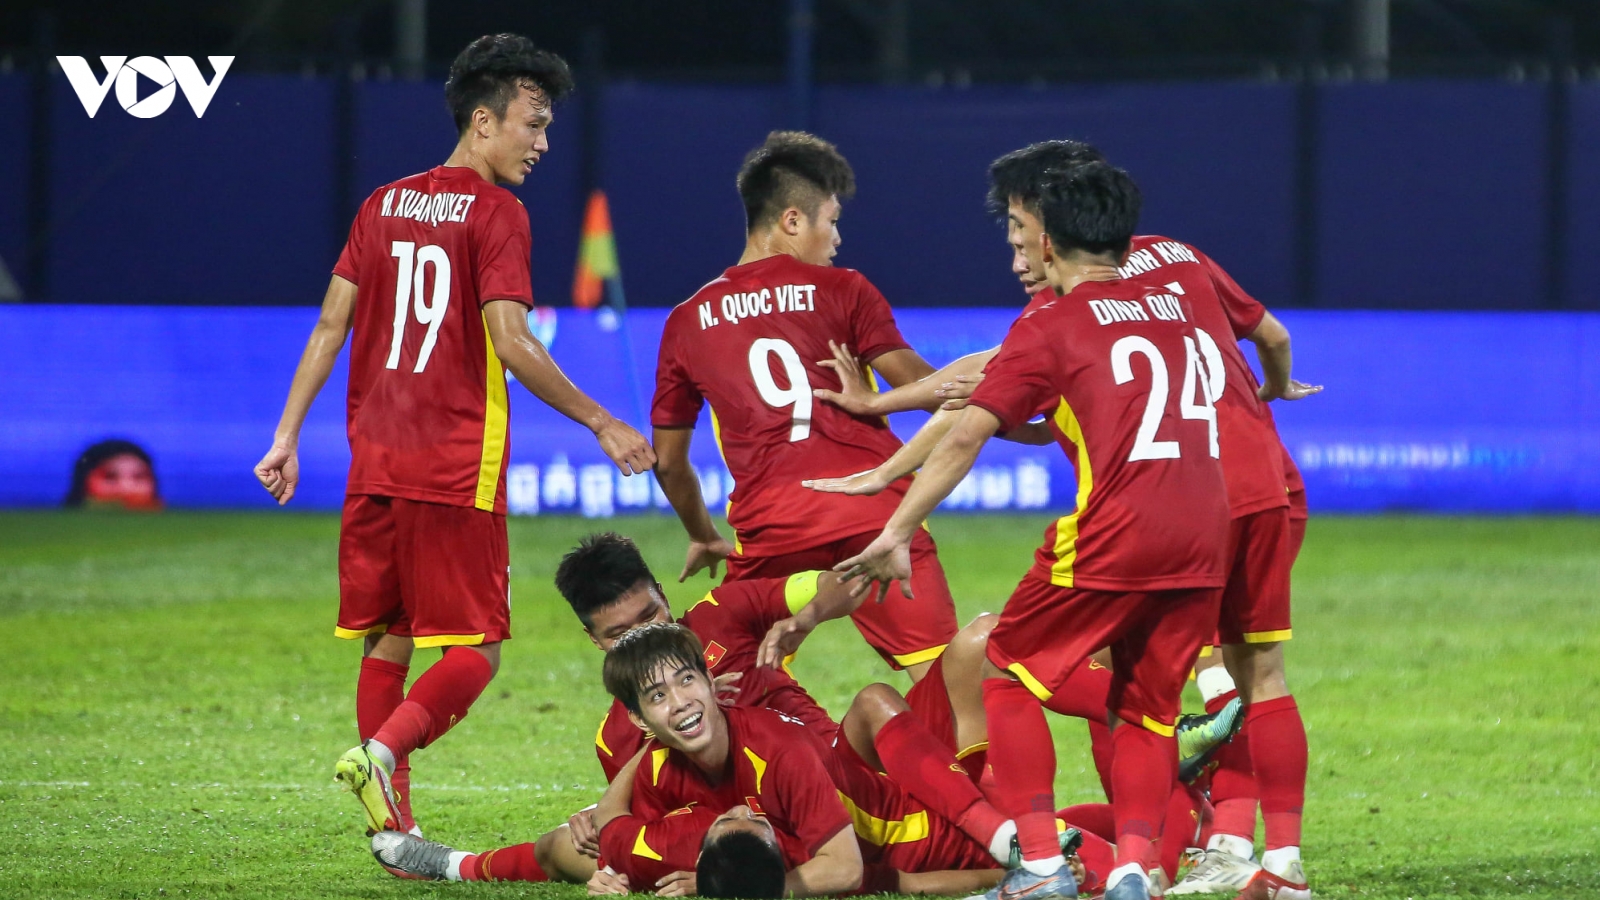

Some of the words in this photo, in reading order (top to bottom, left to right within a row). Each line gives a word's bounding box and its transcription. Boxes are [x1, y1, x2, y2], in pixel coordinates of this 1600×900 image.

[385, 240, 451, 374] 19
[699, 301, 719, 330] N.
[721, 288, 773, 325] QUOC
[775, 284, 816, 313] VIET
[1088, 298, 1150, 326] DINH
[748, 337, 813, 443] 9
[1110, 335, 1220, 462] 24
